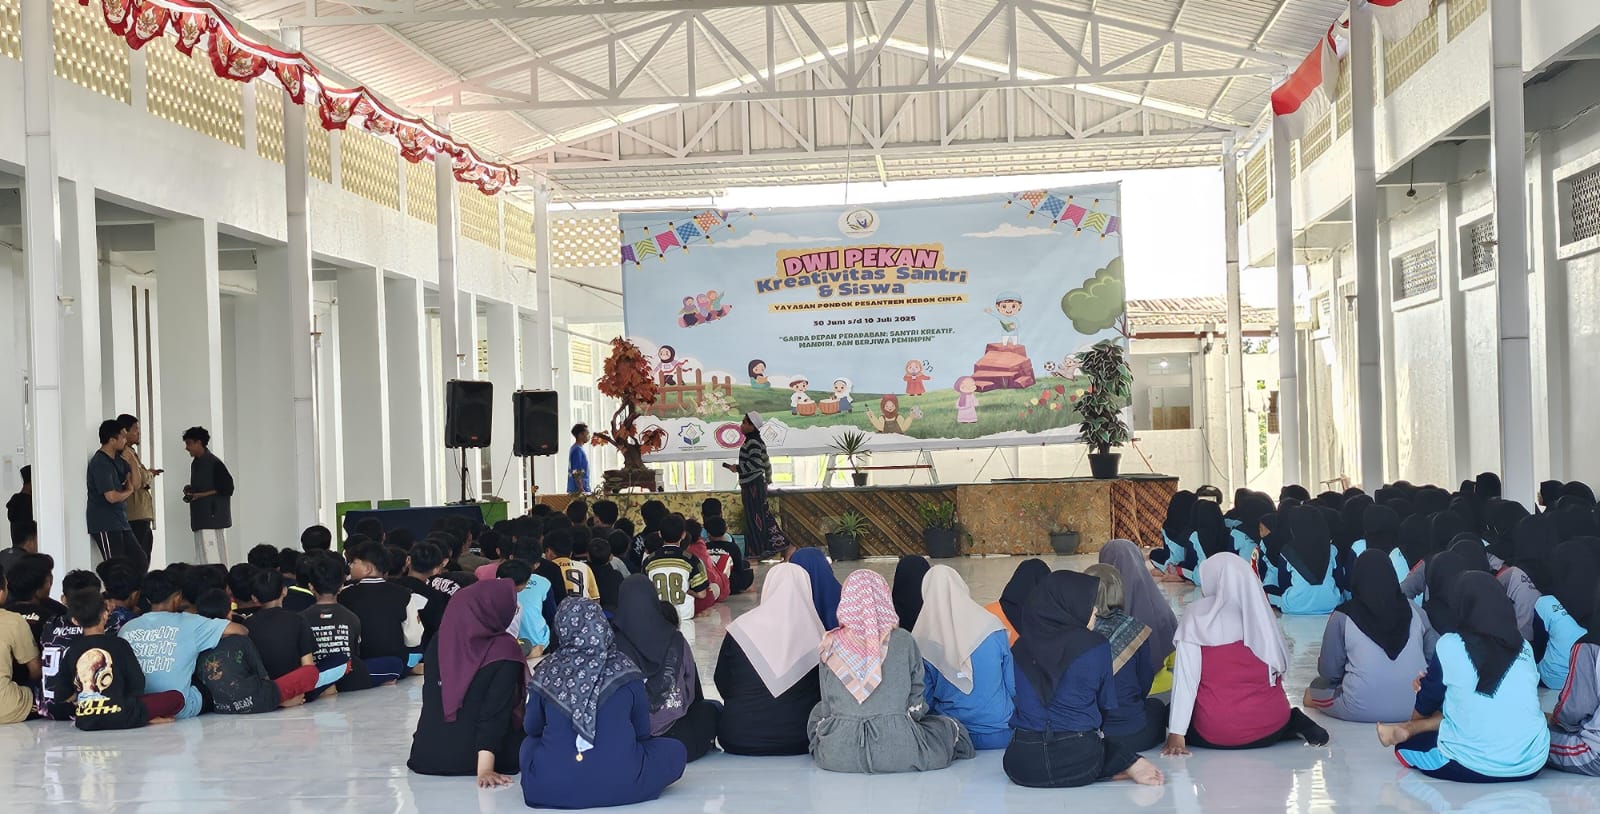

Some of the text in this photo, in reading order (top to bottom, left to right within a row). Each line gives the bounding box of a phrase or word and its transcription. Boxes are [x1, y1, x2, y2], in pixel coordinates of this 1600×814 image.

[783, 247, 939, 277] DWI PEKAN
[757, 266, 967, 294] Kreativitas Santri
[819, 282, 905, 298] & Siswa
[774, 295, 963, 311] YAYASAN PONDOK PESANTREN KEBON CINTA
[811, 333, 837, 341] DEPAN
[890, 329, 919, 337] SANTRI
[854, 337, 890, 346] BERJIWA
[566, 569, 584, 598] 9
